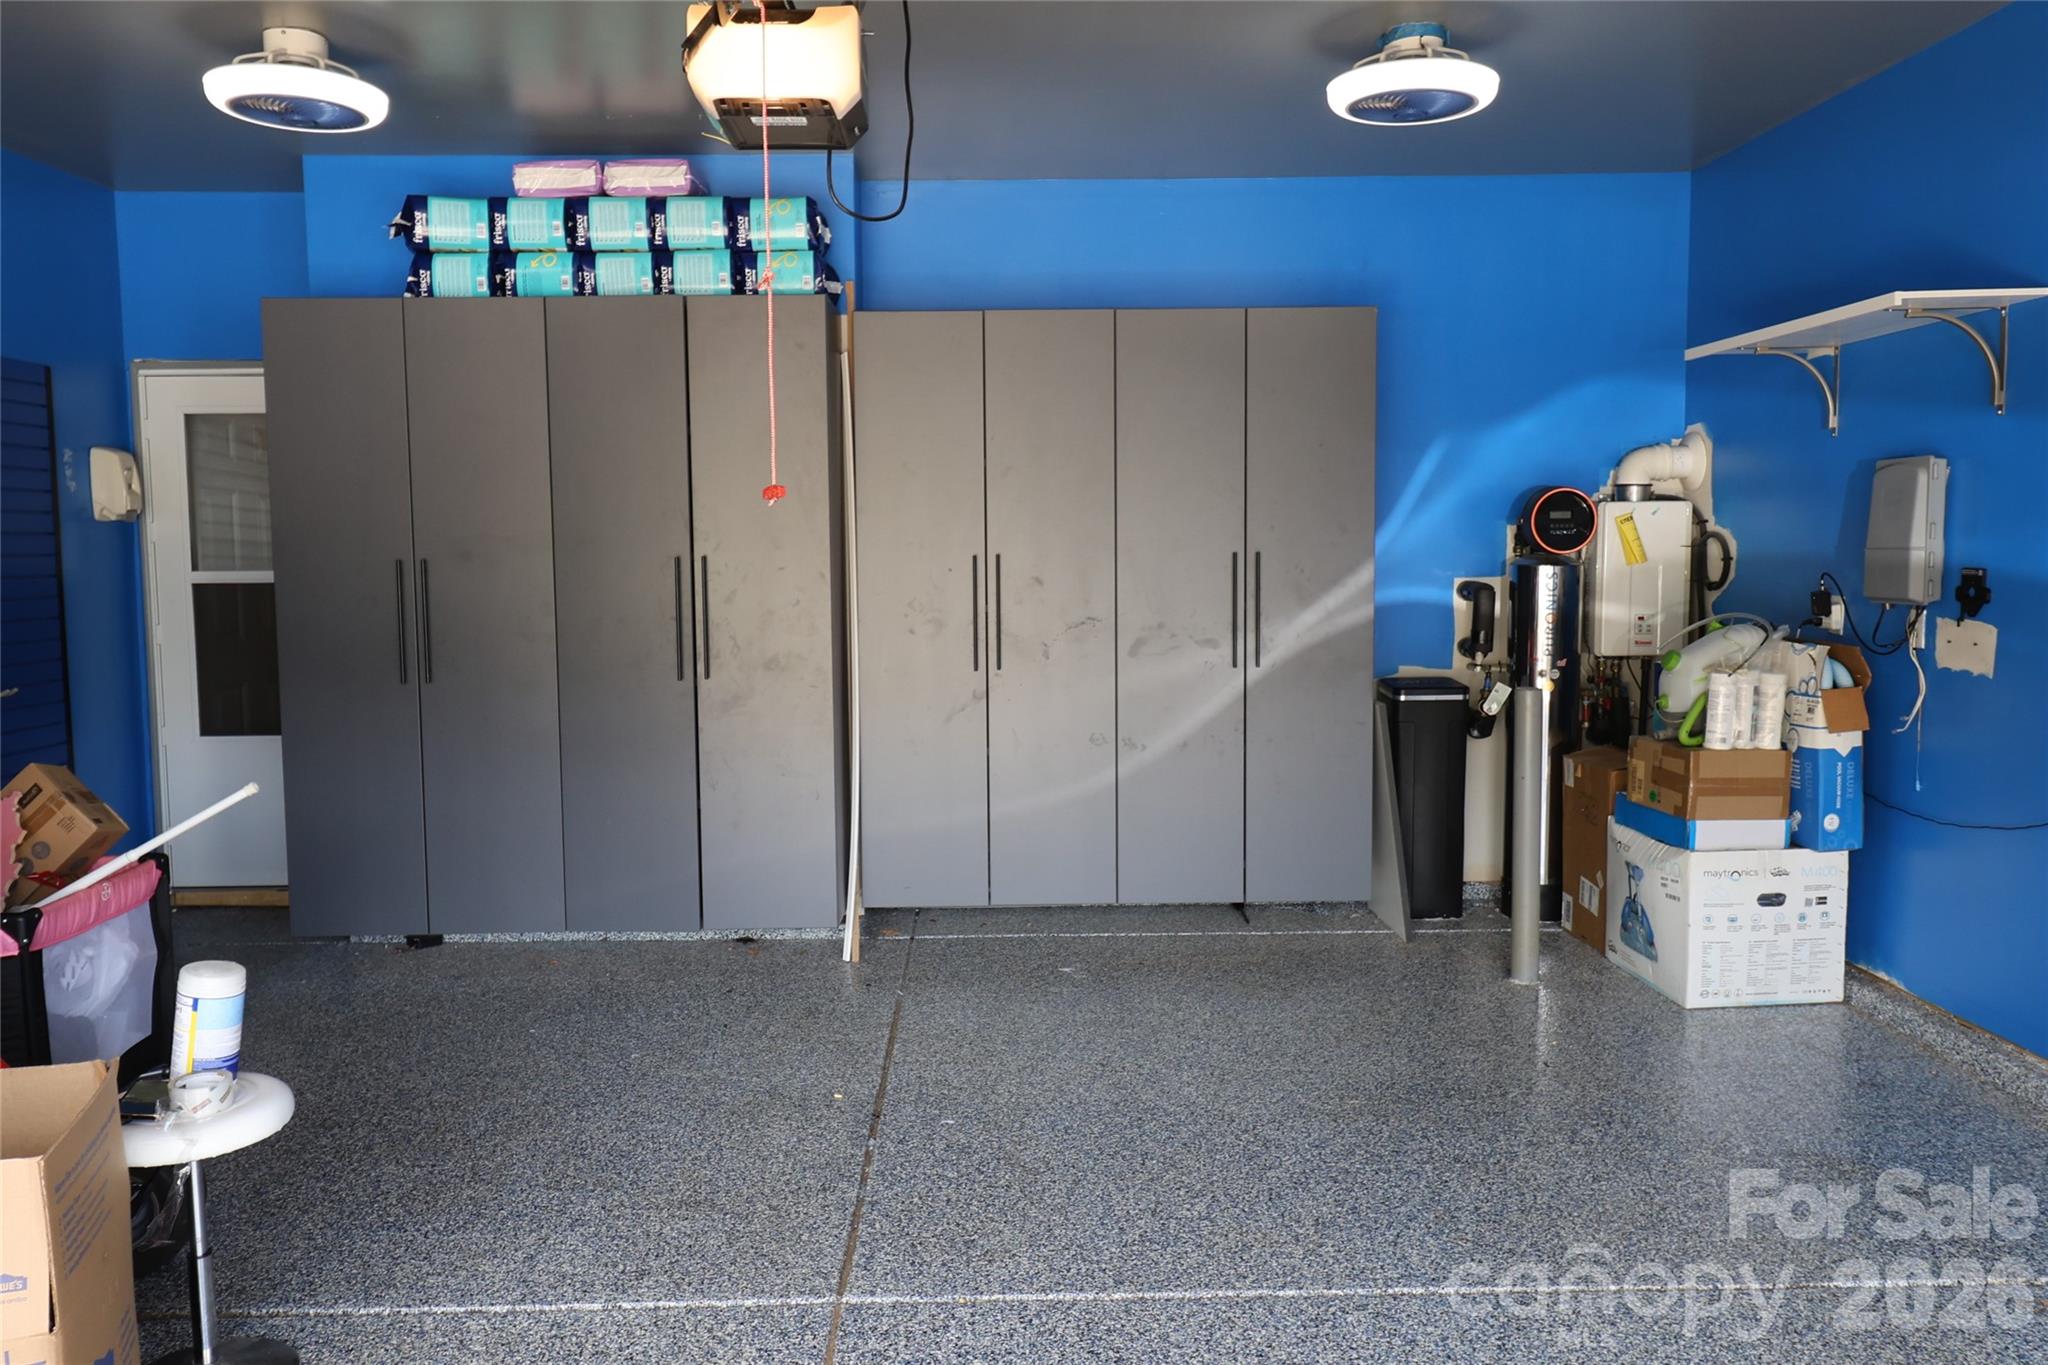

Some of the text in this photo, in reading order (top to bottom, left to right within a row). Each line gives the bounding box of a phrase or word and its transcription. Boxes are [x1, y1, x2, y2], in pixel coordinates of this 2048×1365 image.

[413, 211, 422, 244] frisco
[493, 212, 504, 245] frisco
[575, 214, 586, 247] frisco
[736, 215, 747, 248] frisco
[419, 269, 429, 298] risco
[743, 268, 754, 295] risco
[1543, 571, 1559, 657] PURONICS
[1846, 761, 1854, 800] DELUXE
[1703, 867, 1759, 881] maytronics
